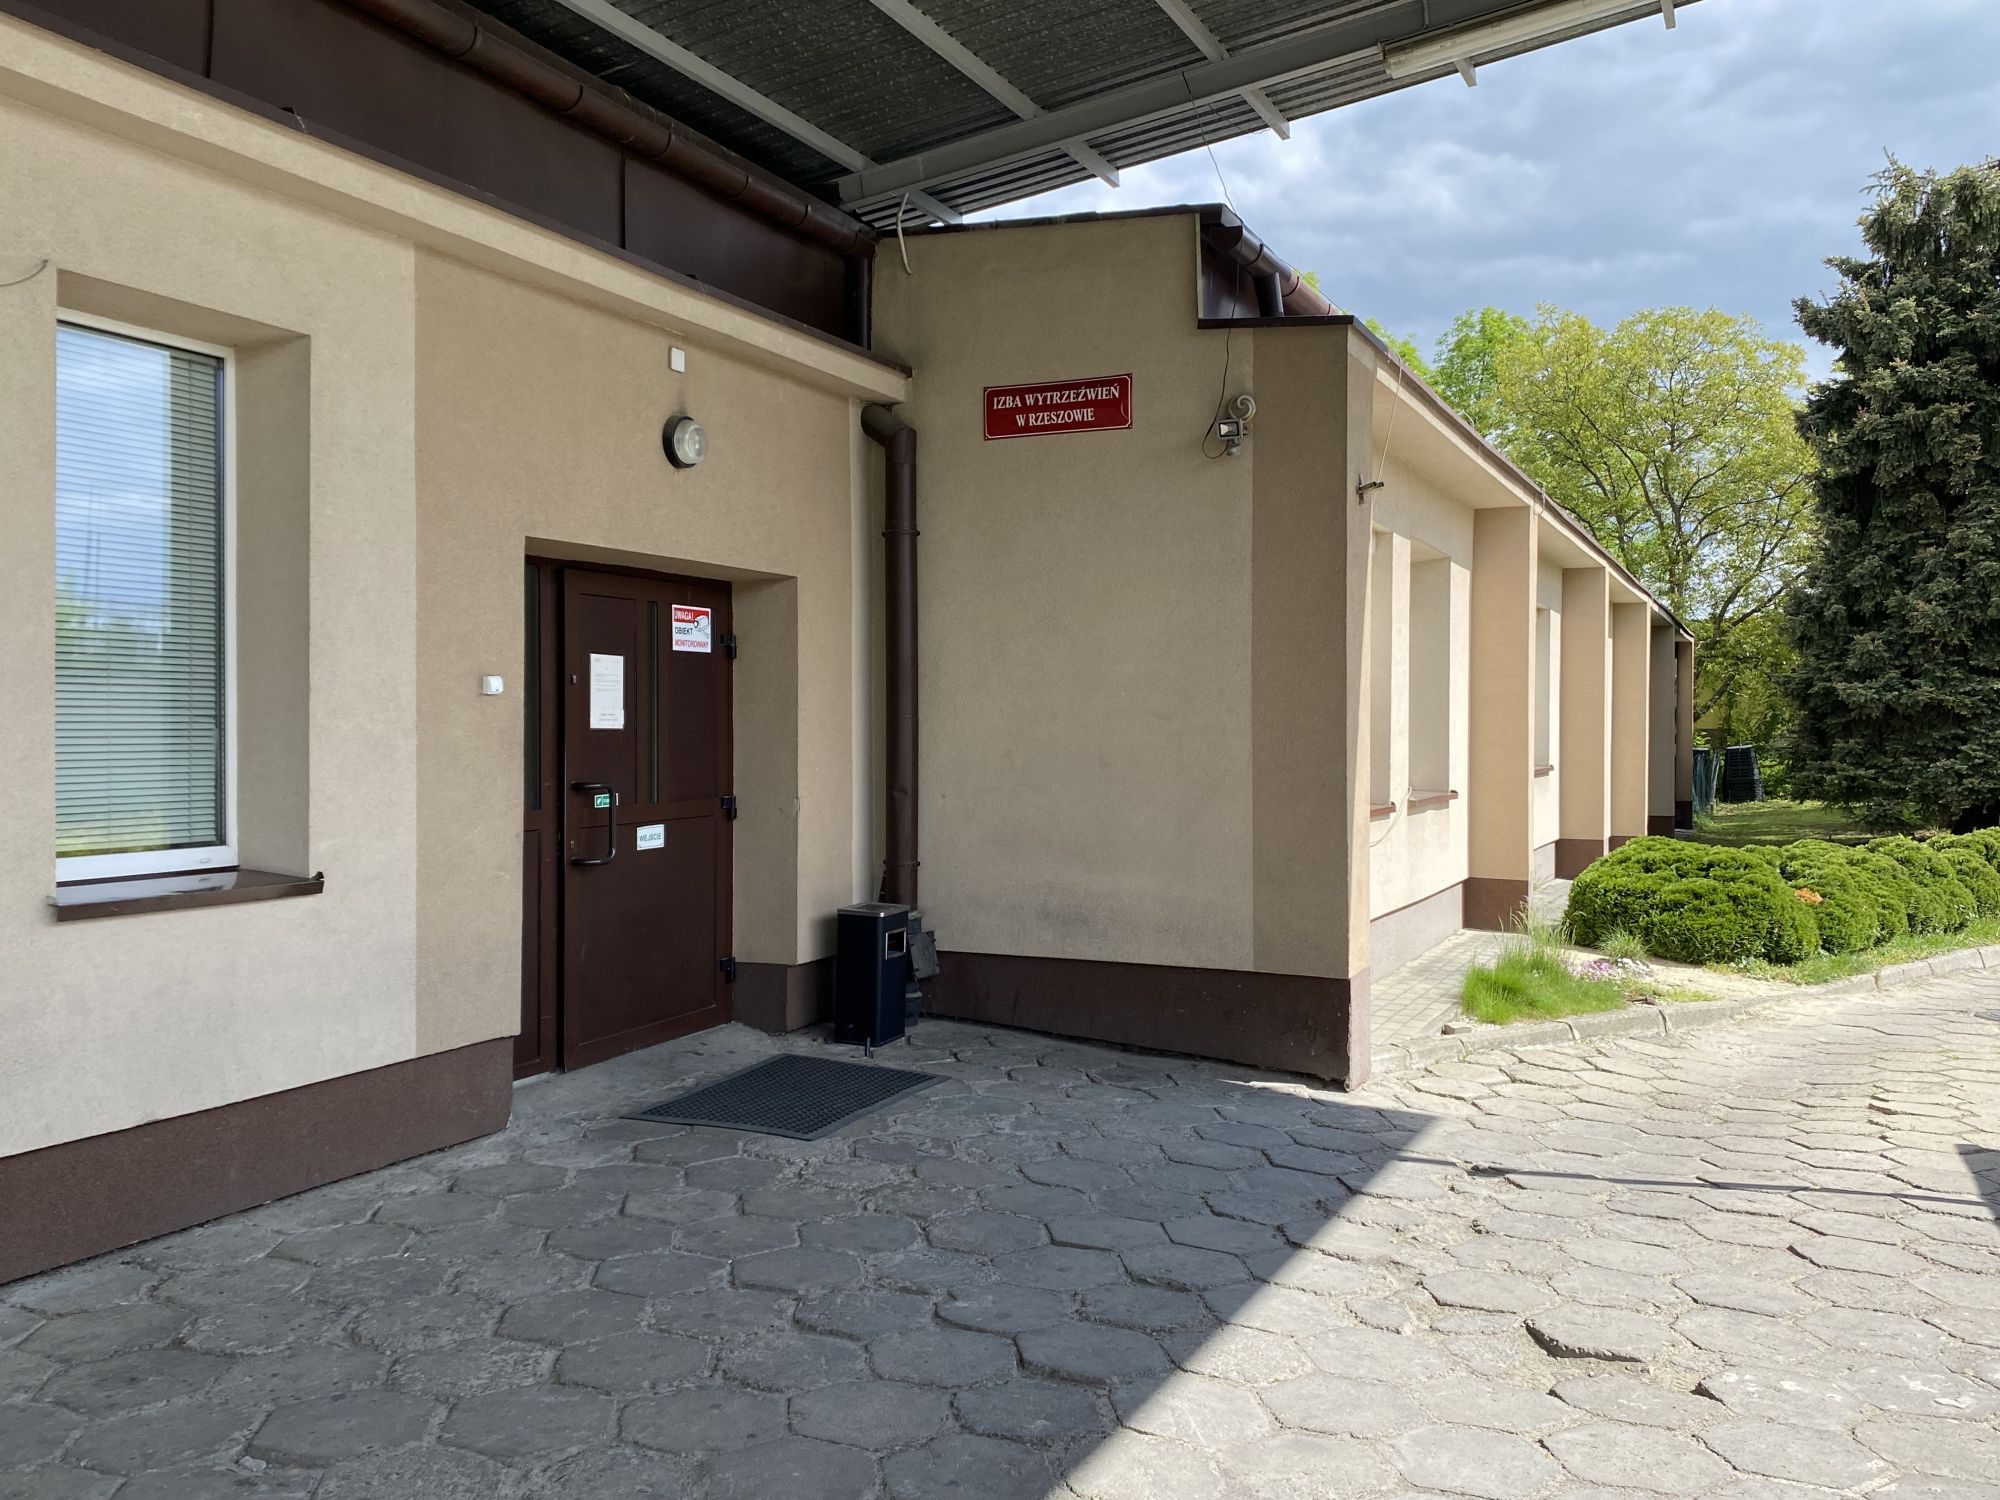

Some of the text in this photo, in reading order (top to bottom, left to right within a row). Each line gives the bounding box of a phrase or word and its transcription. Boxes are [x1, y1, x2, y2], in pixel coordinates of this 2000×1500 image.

[993, 384, 1120, 410] IZBA WYTRZEŹWIEŃ
[1016, 408, 1095, 427] W RZESZOWIE
[674, 611, 694, 620] UWAGA!
[675, 627, 693, 635] OBIEKT
[675, 639, 709, 648] MONITOROWANY
[639, 833, 661, 842] WEJŚCIE
